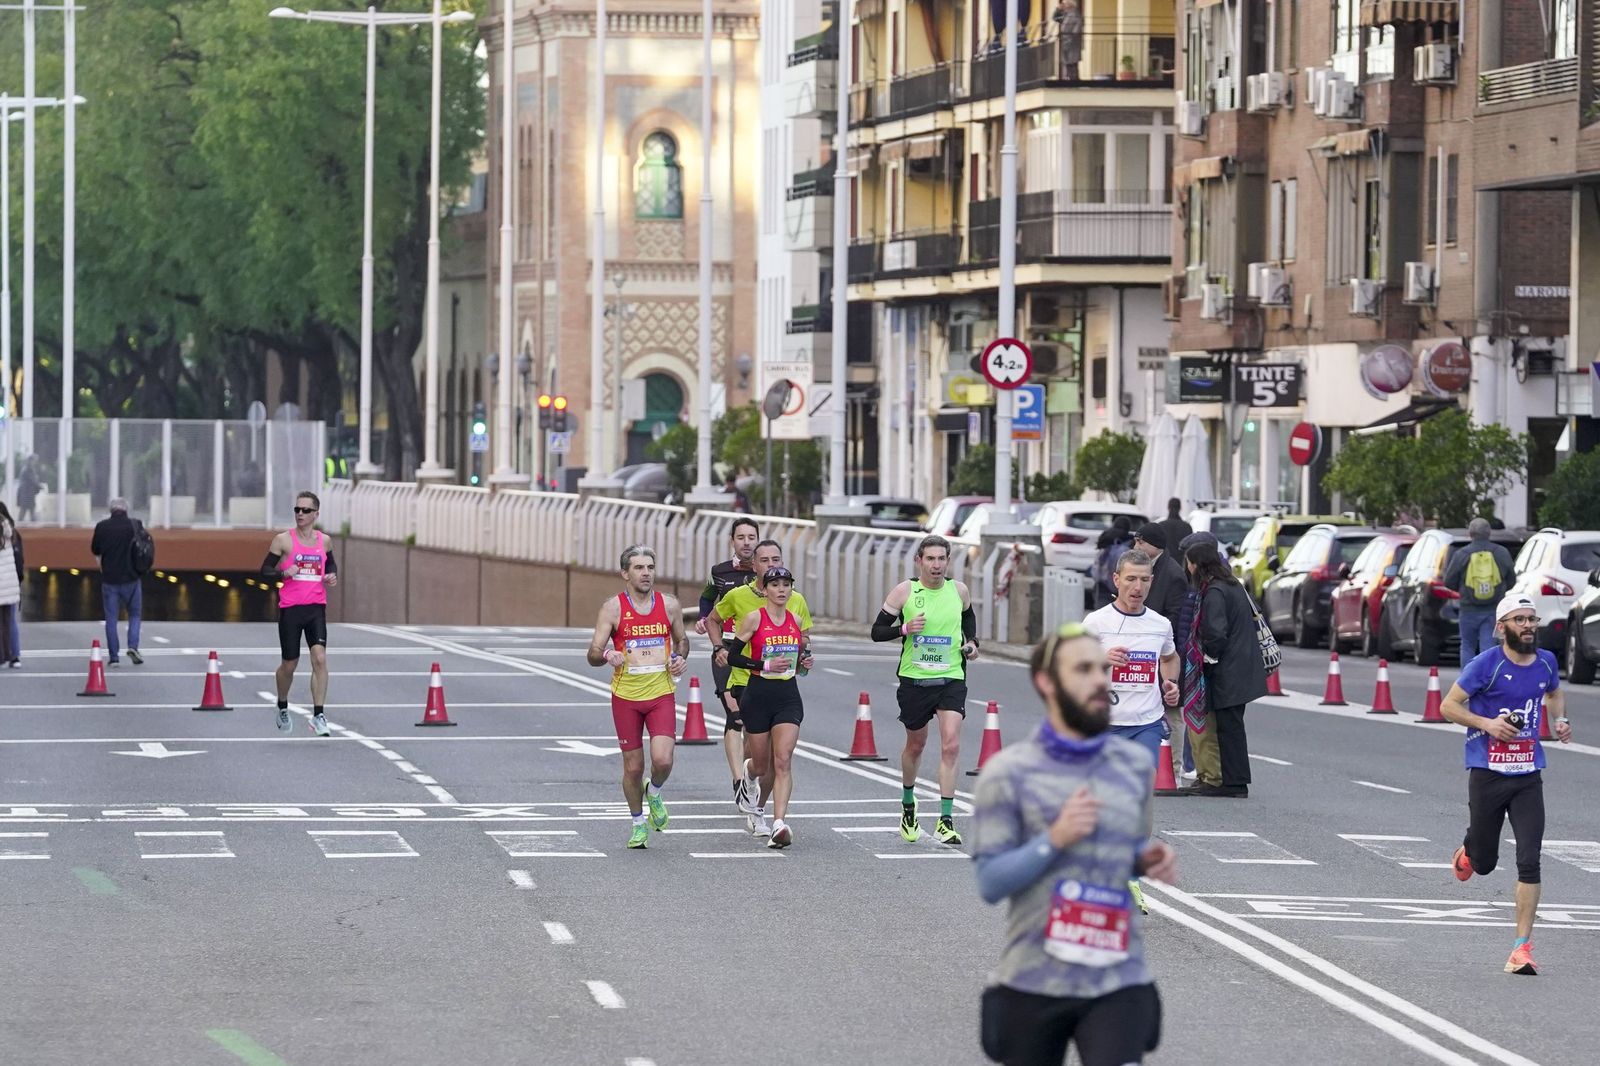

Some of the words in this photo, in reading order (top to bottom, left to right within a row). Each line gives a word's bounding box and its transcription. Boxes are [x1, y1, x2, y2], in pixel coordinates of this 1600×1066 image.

[1238, 366, 1296, 381] TINTE
[1252, 381, 1288, 407] 5€
[1012, 389, 1035, 419] P
[631, 622, 668, 636] SESEÑA
[765, 635, 799, 646] SESEÑA
[920, 653, 943, 663] JORGE
[1119, 672, 1150, 682] FLOREN
